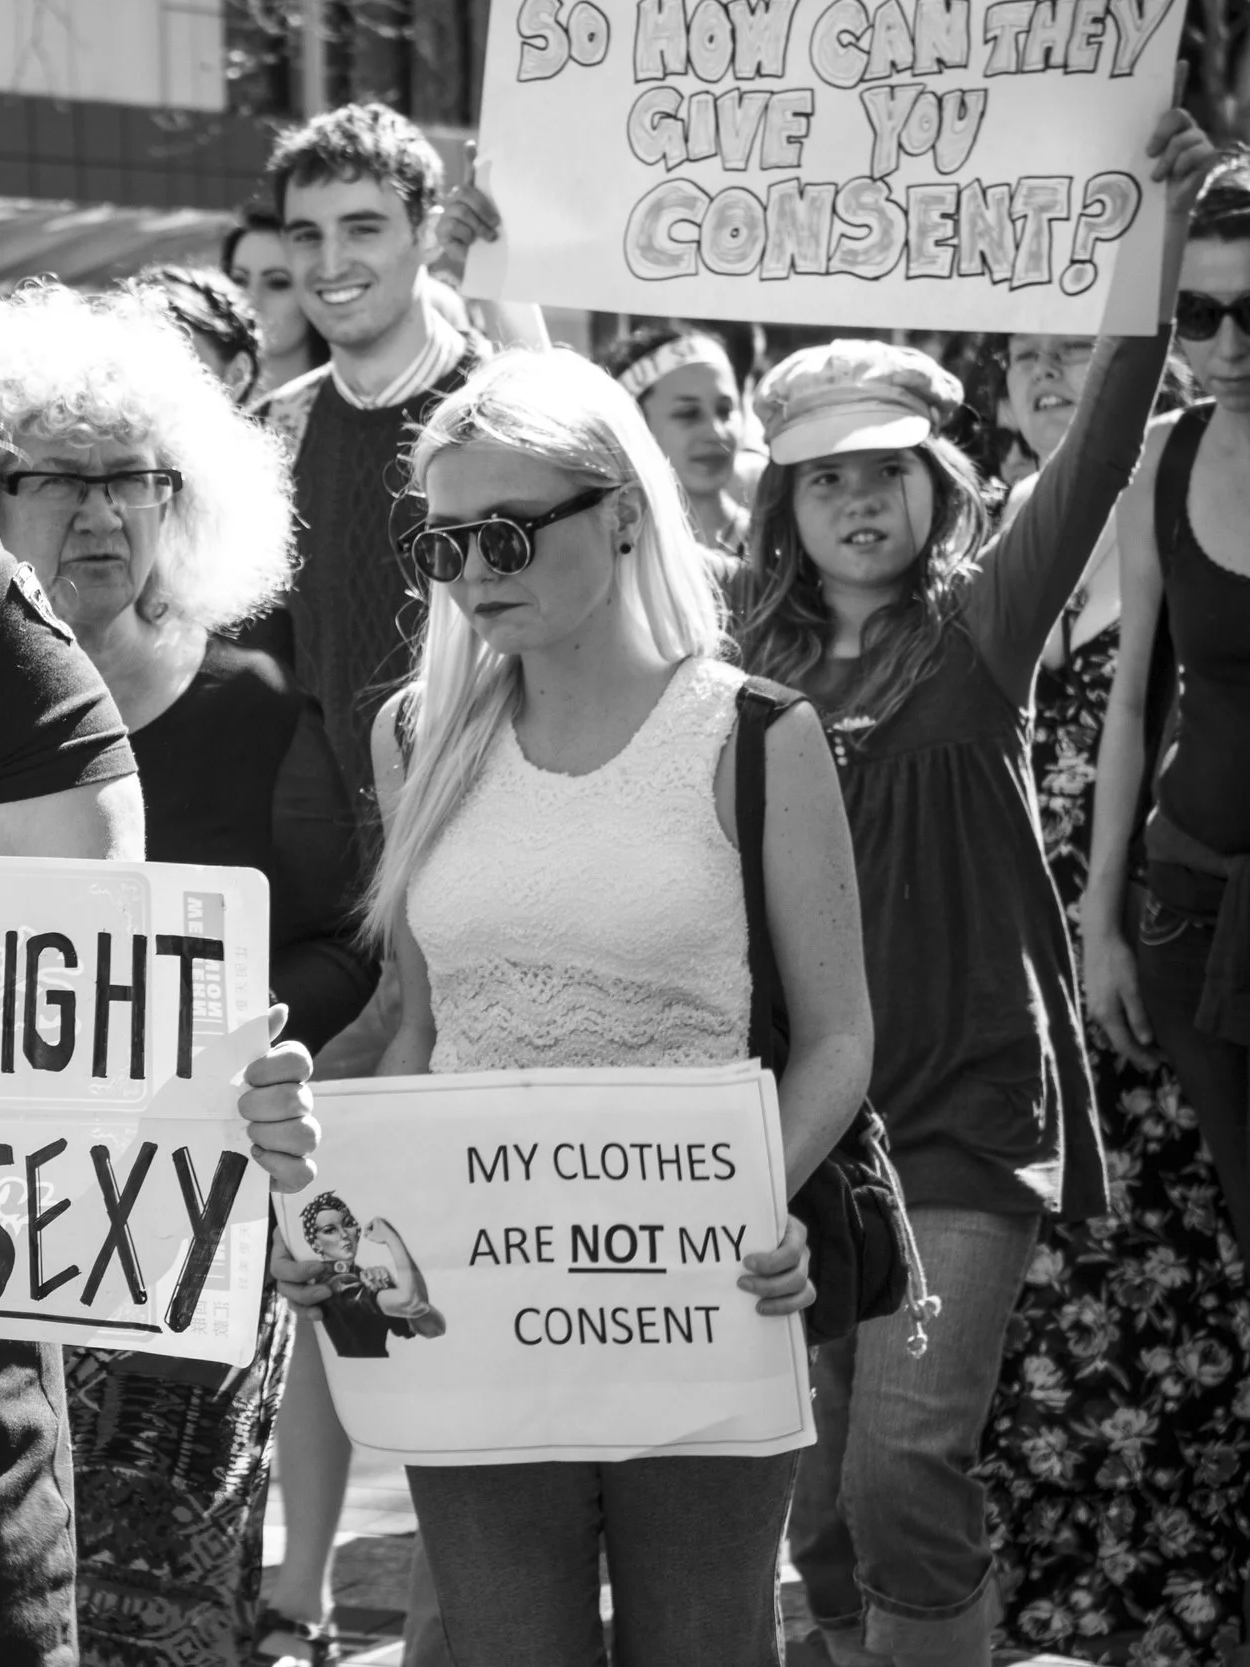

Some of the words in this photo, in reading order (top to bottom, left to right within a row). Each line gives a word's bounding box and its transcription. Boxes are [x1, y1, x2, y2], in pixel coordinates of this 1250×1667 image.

[517, 0, 610, 82] SO
[634, 0, 799, 83] HOW
[810, 0, 970, 88] CAN
[984, 0, 1173, 78] THEY
[627, 87, 814, 171] GIVE
[860, 83, 988, 179] YOU
[624, 171, 1142, 295] CONSENT?
[467, 1143, 538, 1184] MY
[553, 1142, 736, 1182] CLOTHES
[469, 1225, 555, 1266] ARE
[570, 1224, 665, 1264] NOT
[679, 1224, 747, 1264] MY
[514, 1306, 720, 1346] CONSENT
